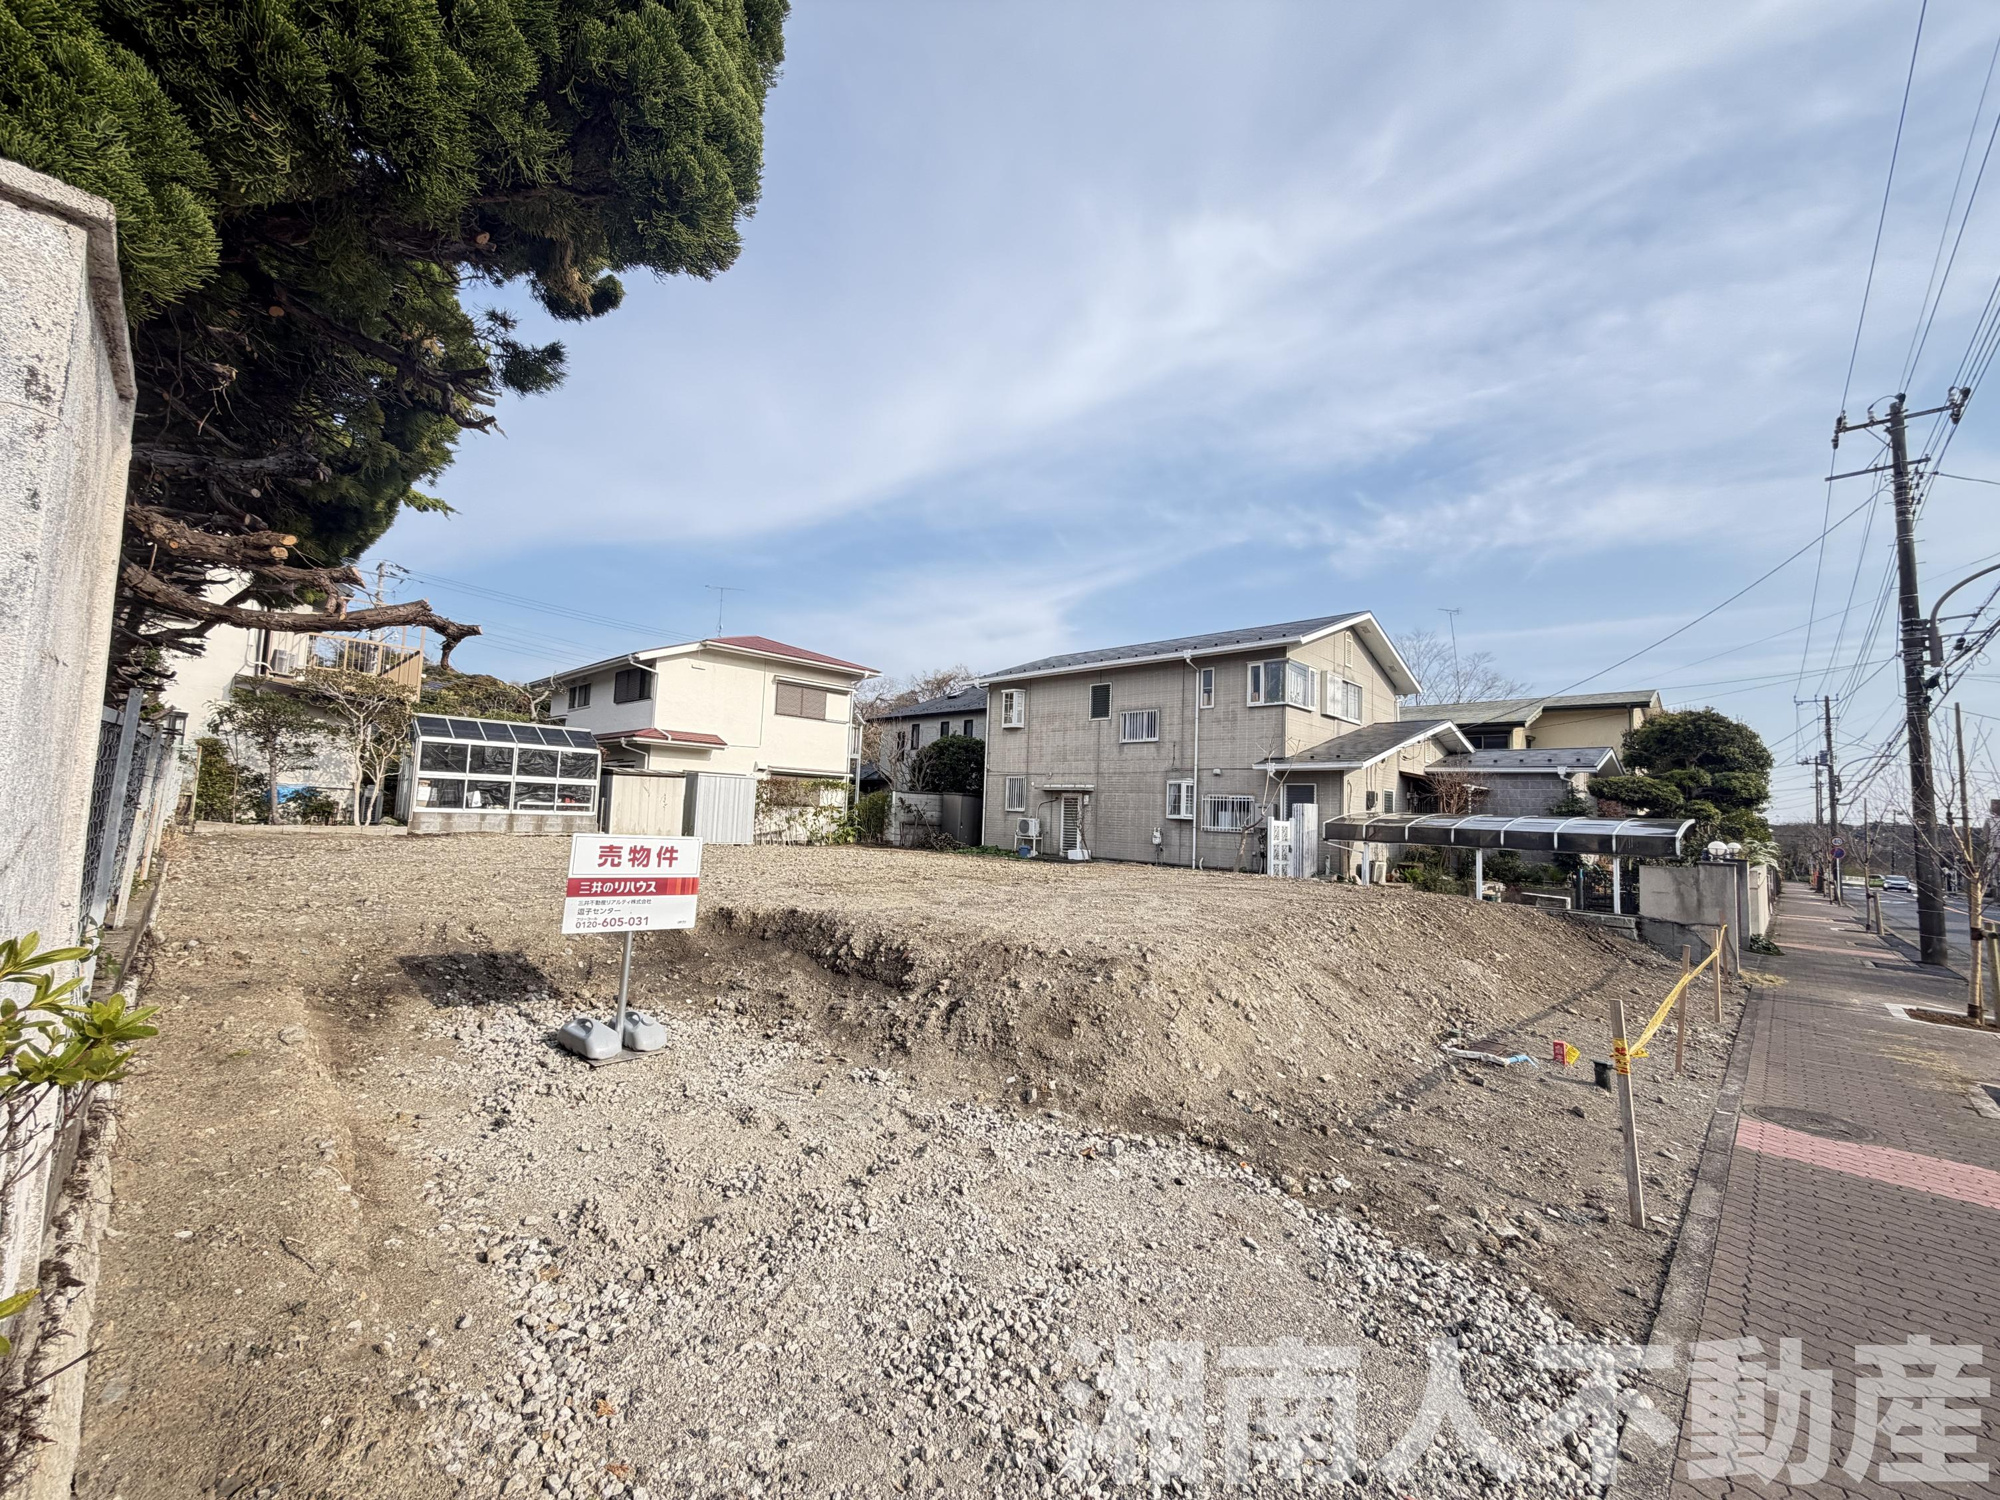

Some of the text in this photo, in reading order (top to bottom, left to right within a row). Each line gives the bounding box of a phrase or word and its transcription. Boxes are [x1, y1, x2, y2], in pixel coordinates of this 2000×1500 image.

[597, 844, 679, 868] 売物件
[579, 881, 657, 894] 三井のリハウス
[577, 908, 621, 916] 逗子センター
[575, 916, 649, 929] 0120-605-031
